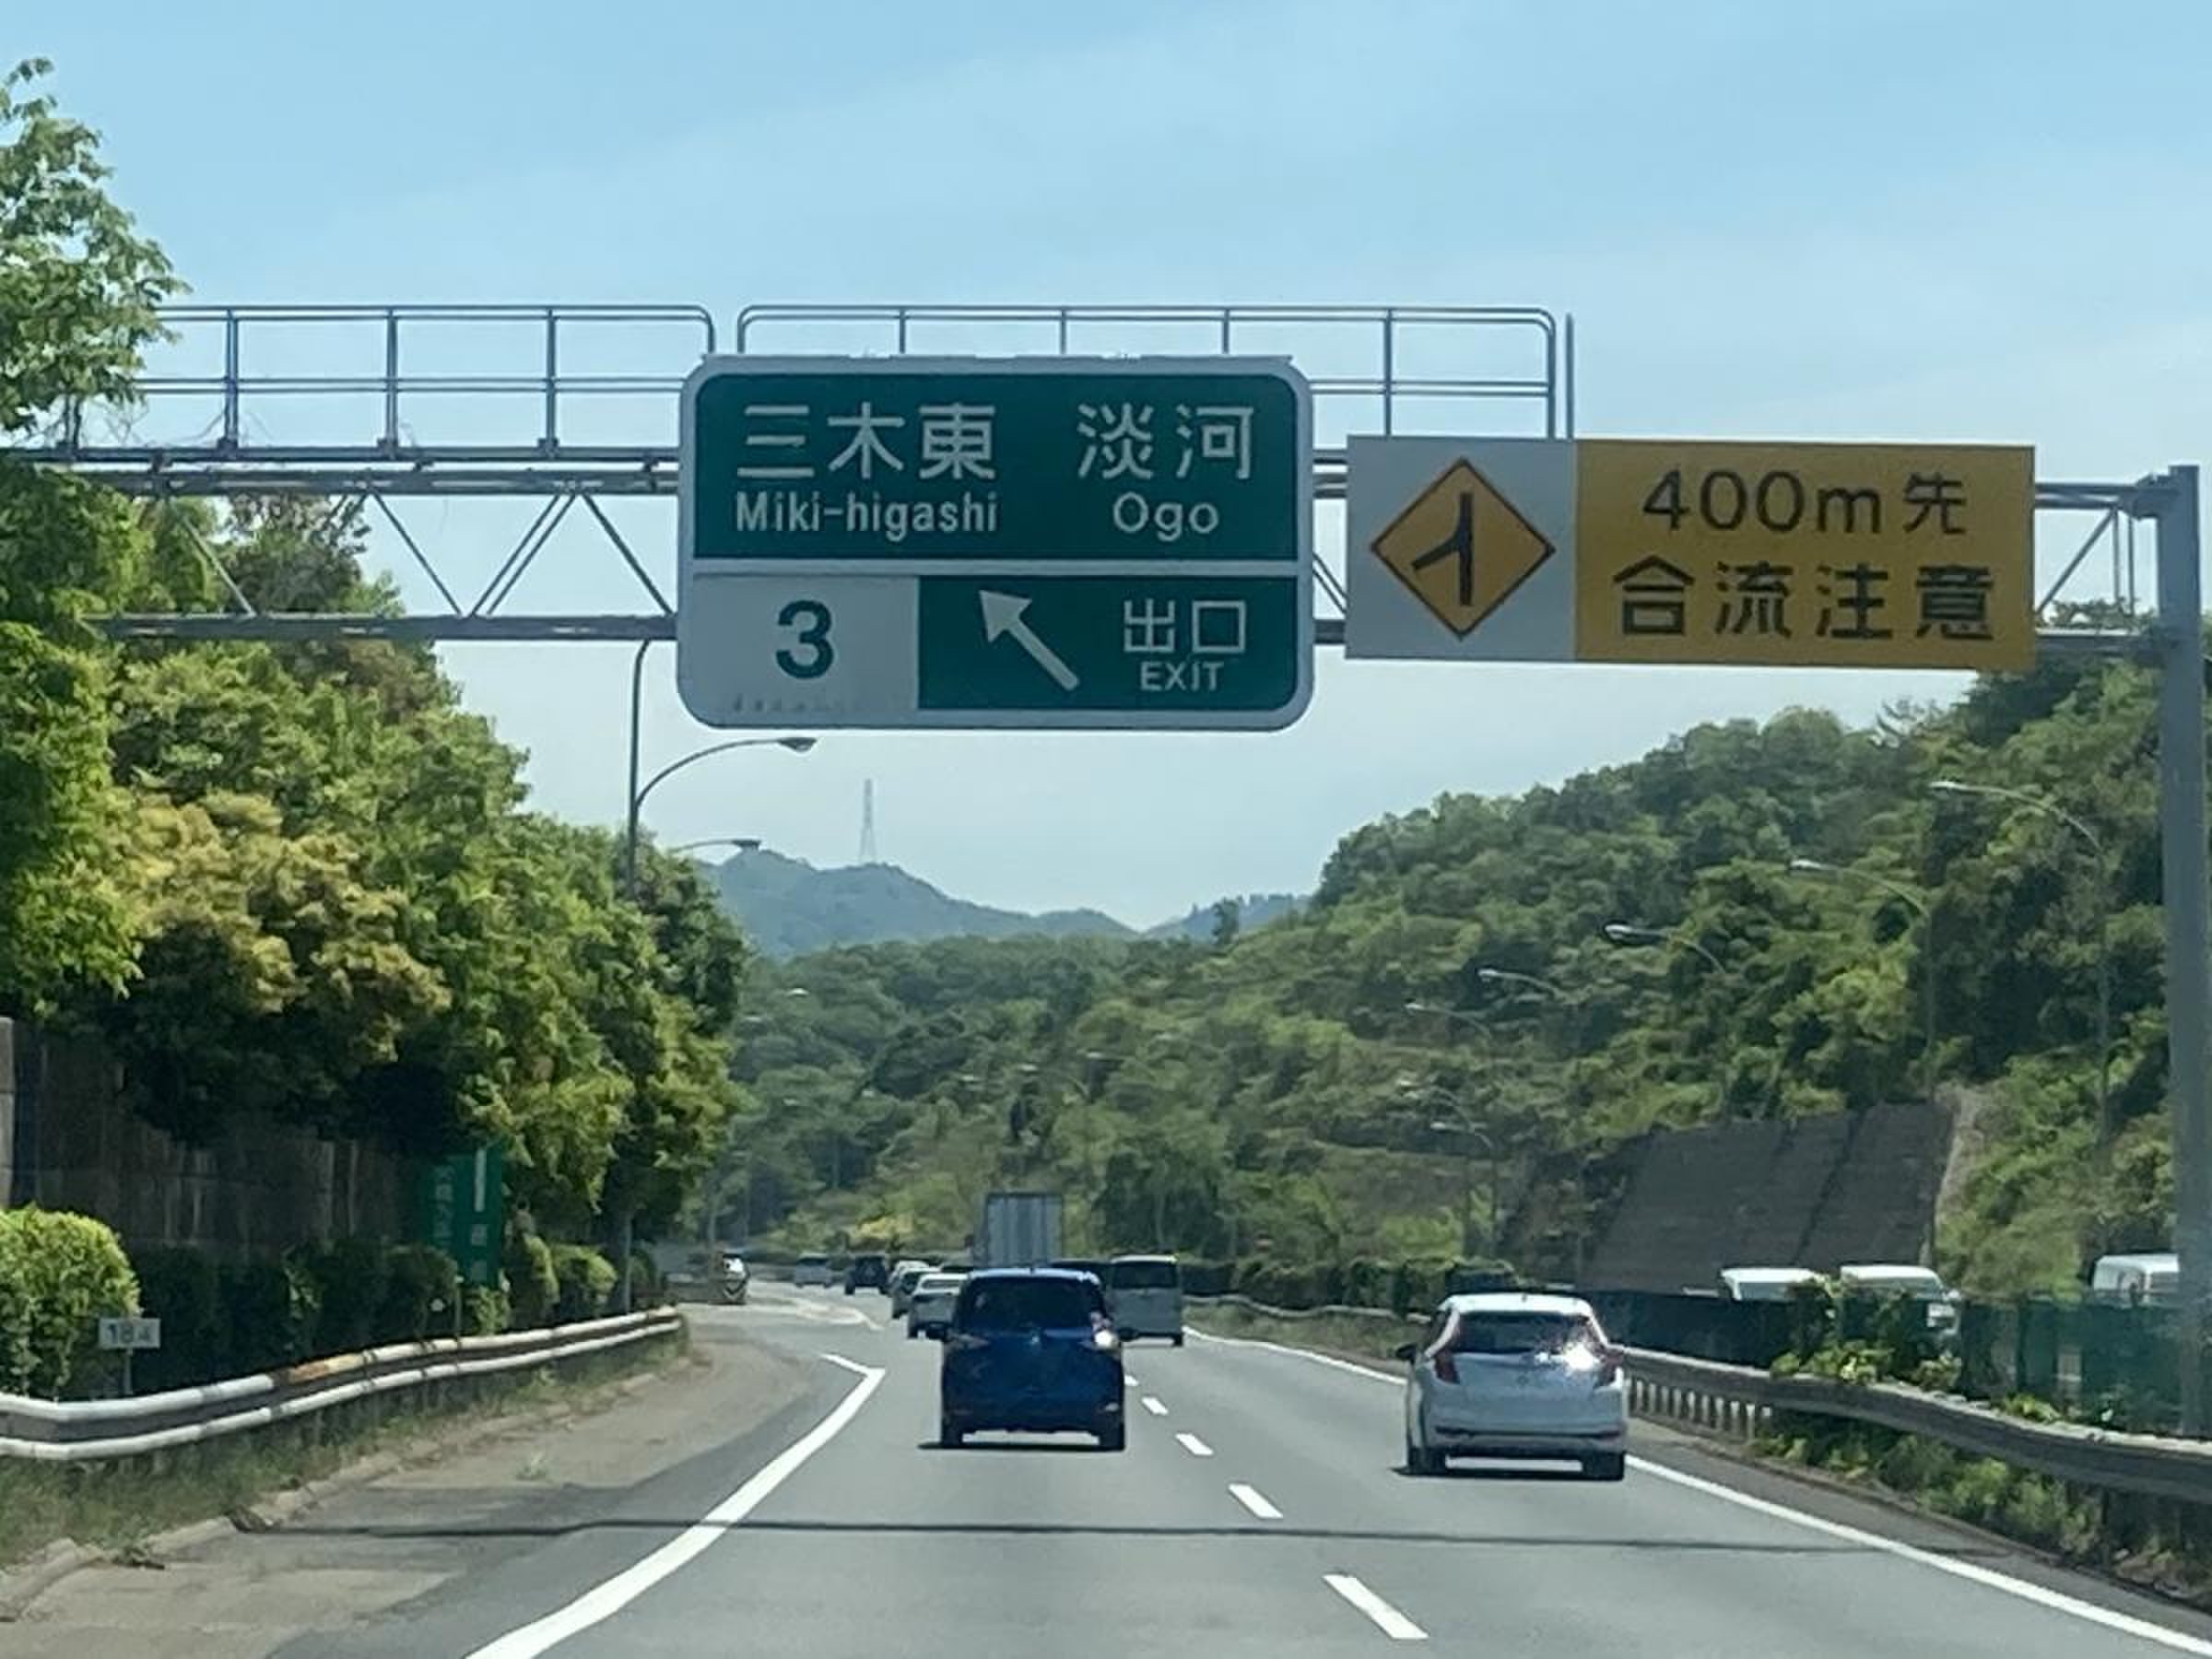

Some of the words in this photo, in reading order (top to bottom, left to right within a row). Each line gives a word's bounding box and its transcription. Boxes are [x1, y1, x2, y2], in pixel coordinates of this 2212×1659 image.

[735, 403, 996, 479] 三木東
[1077, 403, 1254, 479] 淡河
[736, 490, 997, 542] Miki-higashi
[1112, 493, 1219, 541] Ogo
[1641, 469, 1968, 535] 400m先
[1123, 599, 1246, 654] 出口
[1613, 554, 1995, 641] 合流注意
[774, 600, 834, 679] 3
[1139, 660, 1224, 691] EXIT
